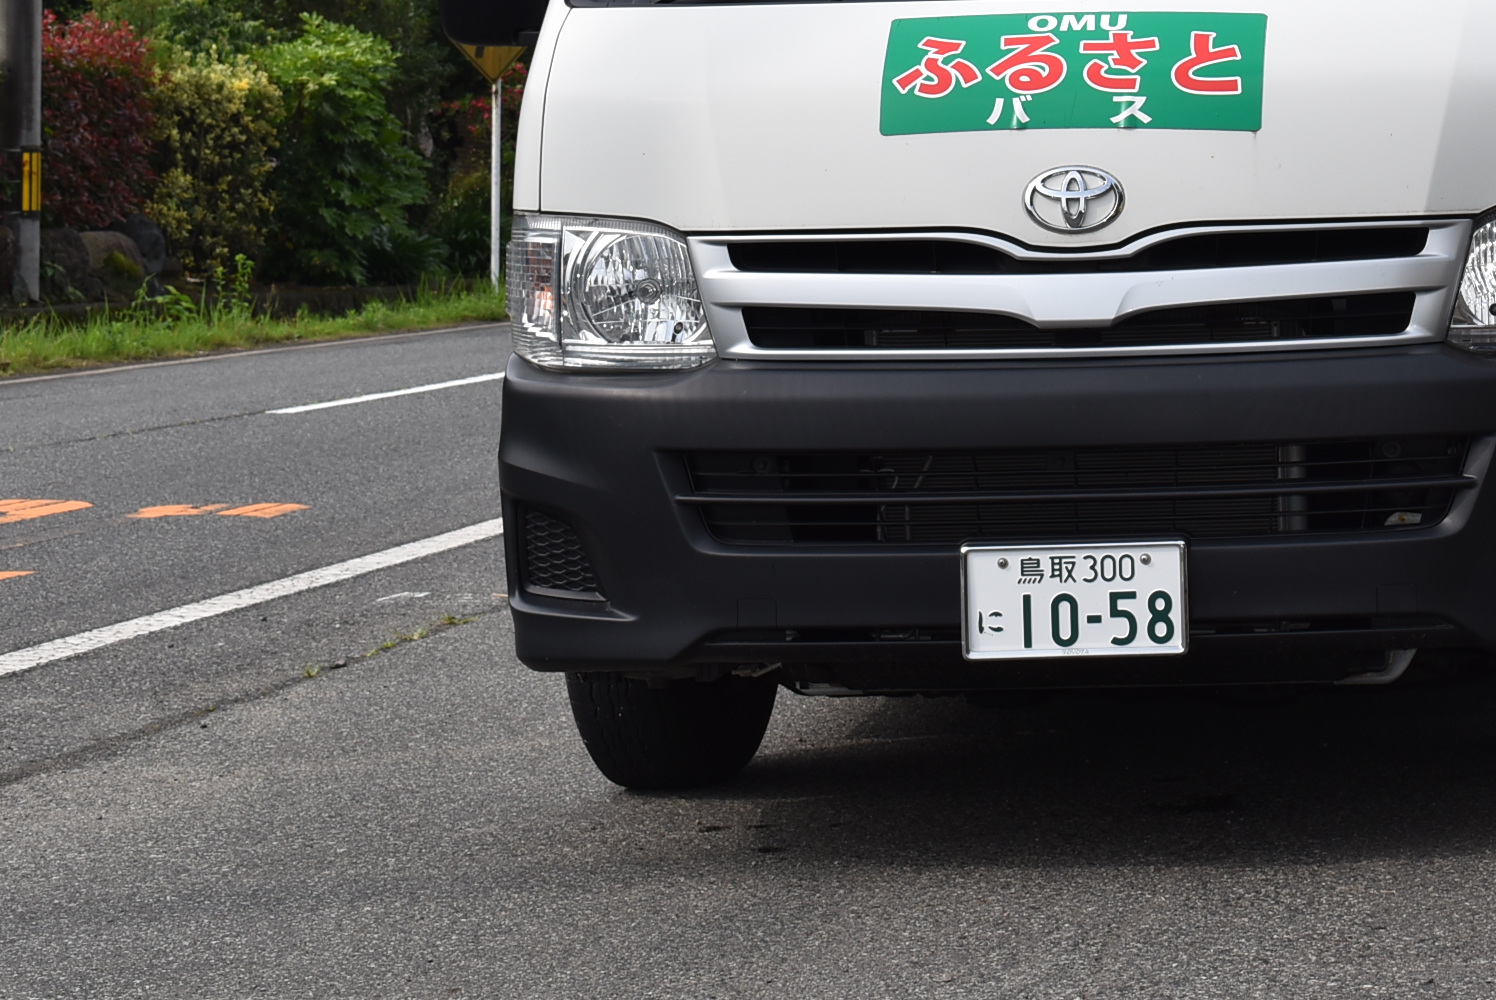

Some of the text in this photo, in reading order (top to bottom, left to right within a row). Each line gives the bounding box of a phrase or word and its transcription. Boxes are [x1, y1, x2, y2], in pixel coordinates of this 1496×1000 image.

[1027, 13, 1128, 32] OMU
[892, 30, 1243, 98] ふるさと
[986, 94, 1153, 125] バス
[1017, 553, 1135, 585] 鳥取300
[978, 589, 1175, 649] に 10-58
